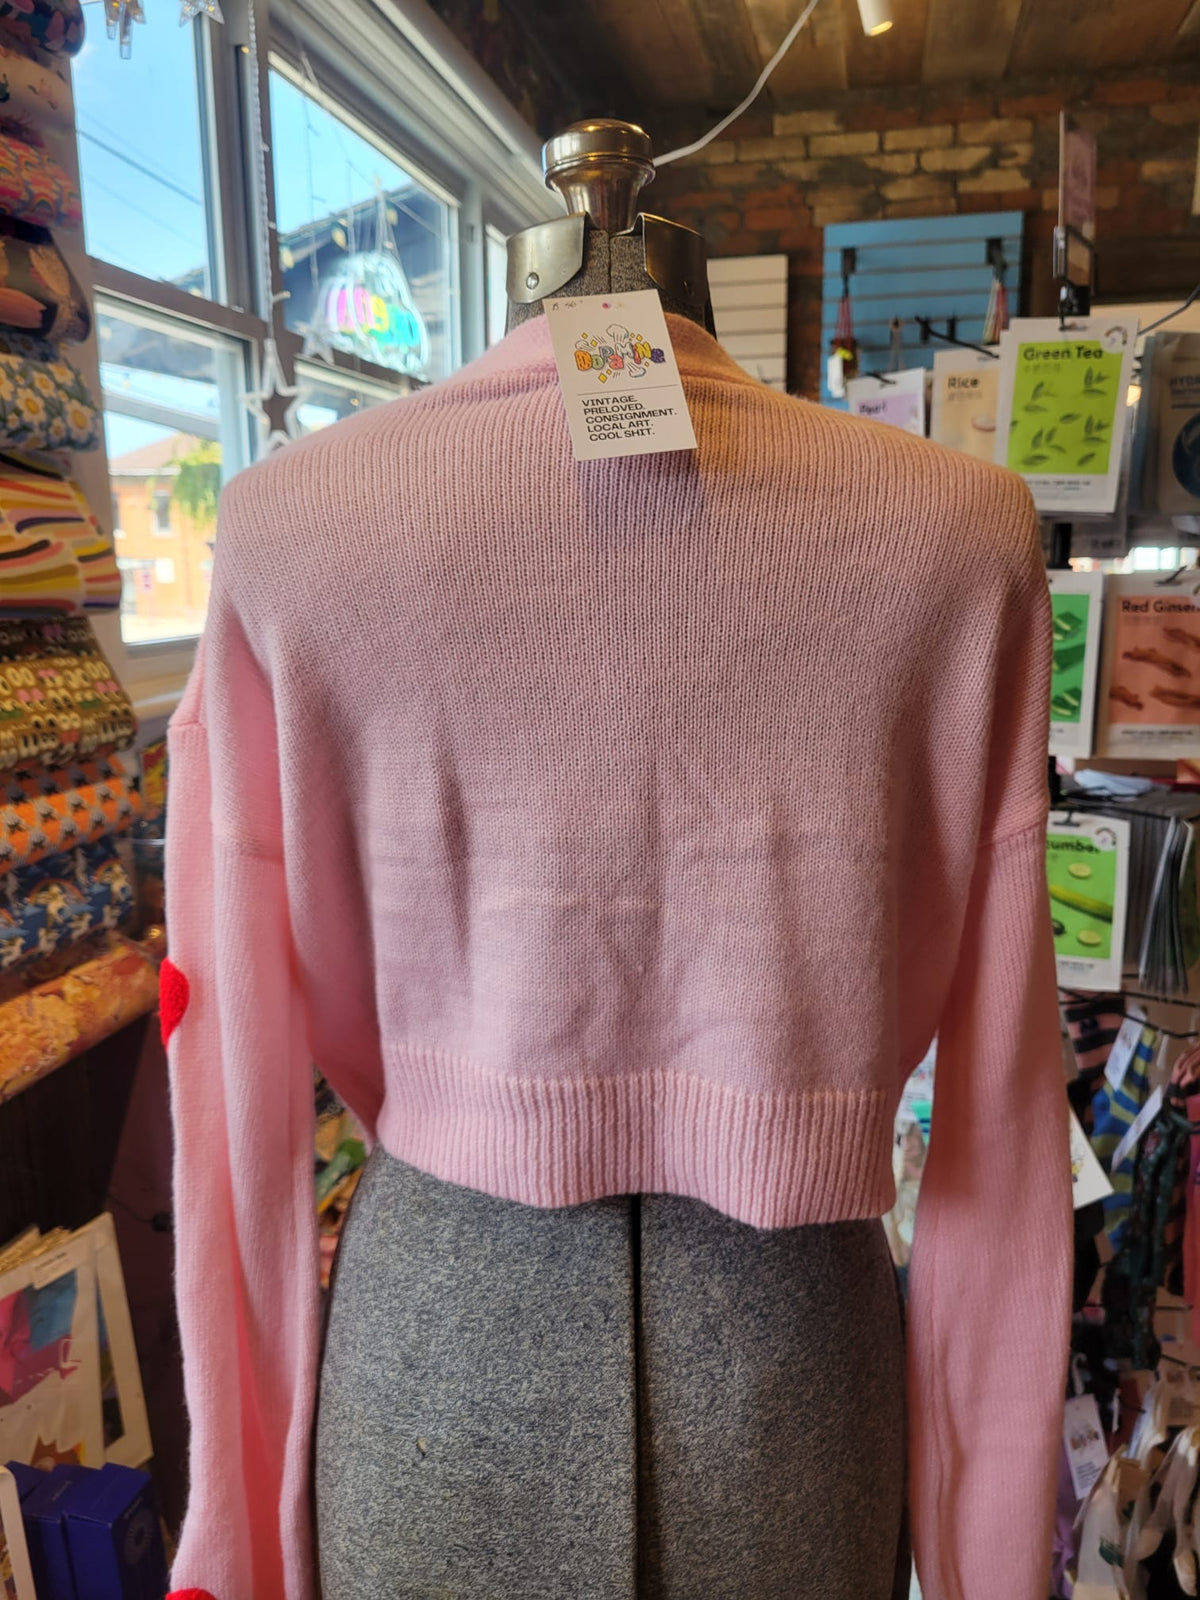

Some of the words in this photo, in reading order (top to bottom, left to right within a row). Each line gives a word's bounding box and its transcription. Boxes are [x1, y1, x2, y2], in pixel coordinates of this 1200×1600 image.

[1023, 347, 1072, 361] Green
[1076, 345, 1103, 360] Tea
[948, 375, 979, 389] Rice
[583, 402, 646, 416] PRELOVED.
[585, 408, 678, 424] CONSIGNMENT.
[587, 422, 627, 433] LOCAL
[628, 419, 654, 429] ART.
[589, 431, 623, 442] COOL
[624, 428, 656, 438] SHIT.
[1122, 600, 1149, 613] Red
